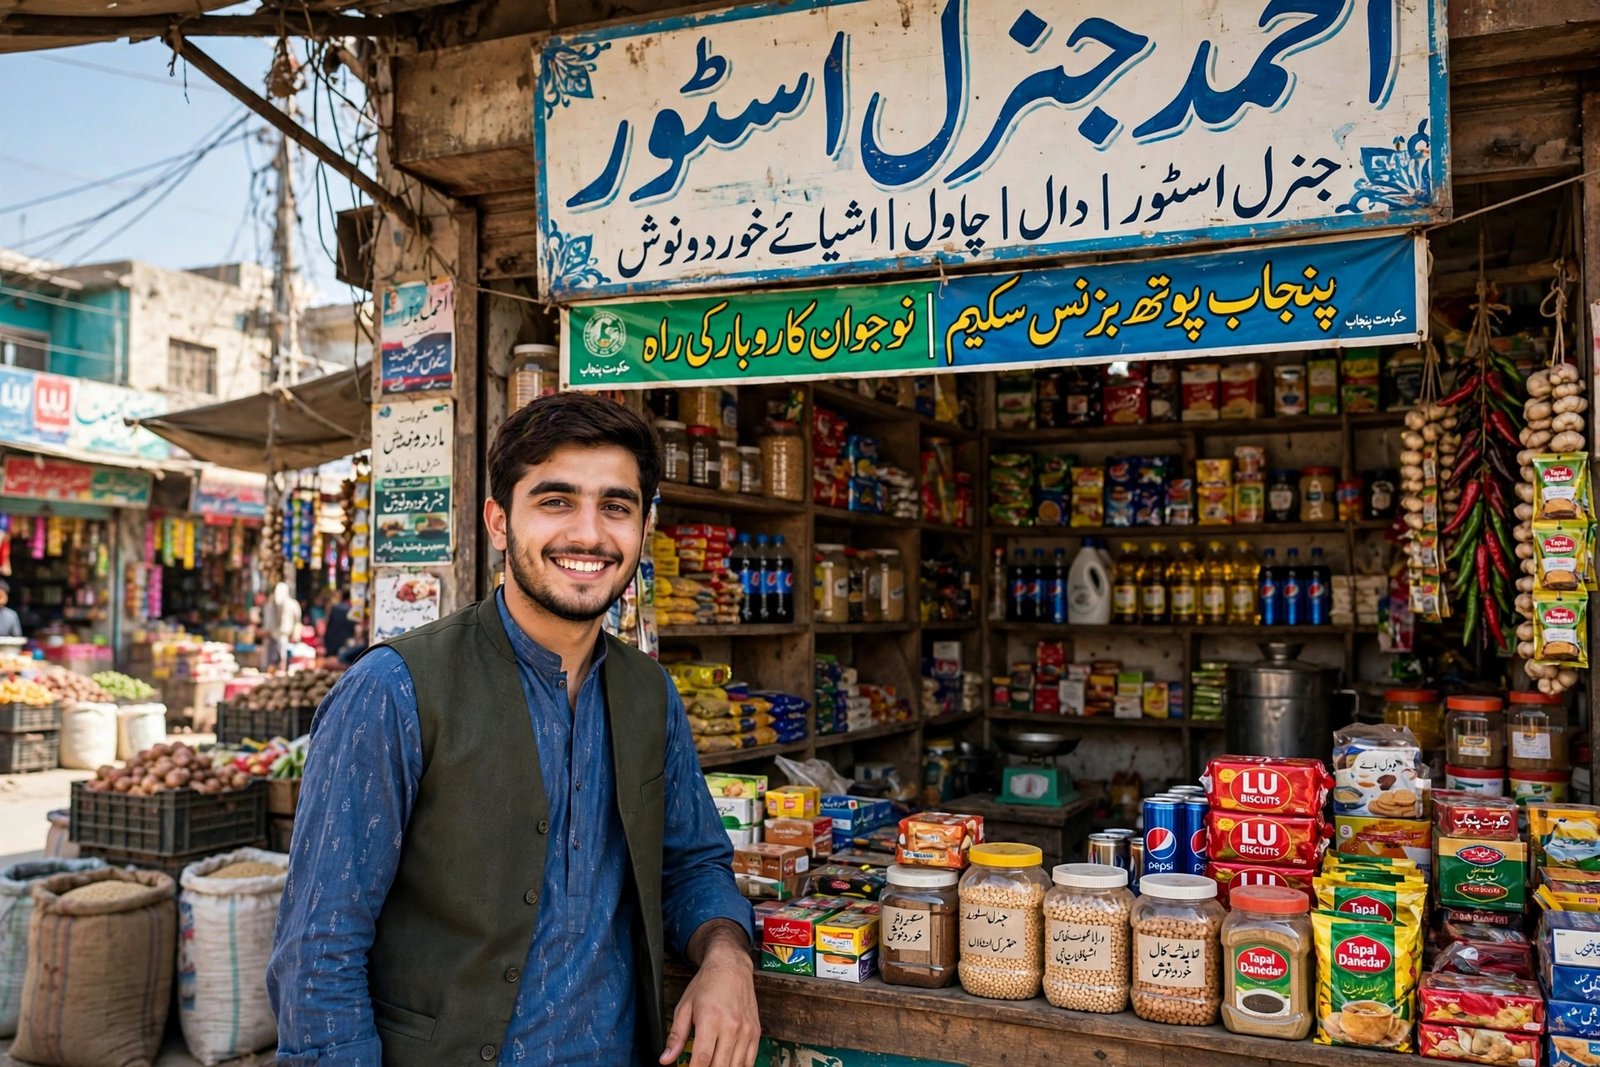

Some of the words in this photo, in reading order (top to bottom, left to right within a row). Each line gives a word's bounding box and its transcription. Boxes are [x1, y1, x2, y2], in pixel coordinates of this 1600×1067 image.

[1132, 0, 1394, 138] احمد
[566, 31, 845, 207] اسٹور
[1120, 162, 1224, 225] اسٹور
[1233, 146, 1341, 218] جنرل
[1019, 174, 1088, 240] دال
[905, 188, 990, 257] چاول
[1207, 260, 1337, 332] پنجاب
[945, 274, 1027, 365] سکیم
[1029, 277, 1121, 346] بزنس
[1345, 314, 1373, 330] پنجاب
[1373, 309, 1407, 326] حکومت
[809, 295, 917, 360] نوجوان
[643, 317, 684, 363] راہ
[580, 362, 602, 378] پنجاب
[602, 360, 630, 375] حکومت
[1242, 772, 1277, 795] LU
[1240, 794, 1280, 805] BISCUITS
[1241, 823, 1276, 846] LU
[1240, 845, 1279, 856] BISCUITS
[1148, 861, 1173, 873] pepsi
[1350, 903, 1379, 916] Tapal
[1248, 952, 1275, 965] Tapal
[1347, 942, 1377, 955] Tapal
[1240, 963, 1283, 976] Danedar
[1338, 954, 1385, 968] Danedar
